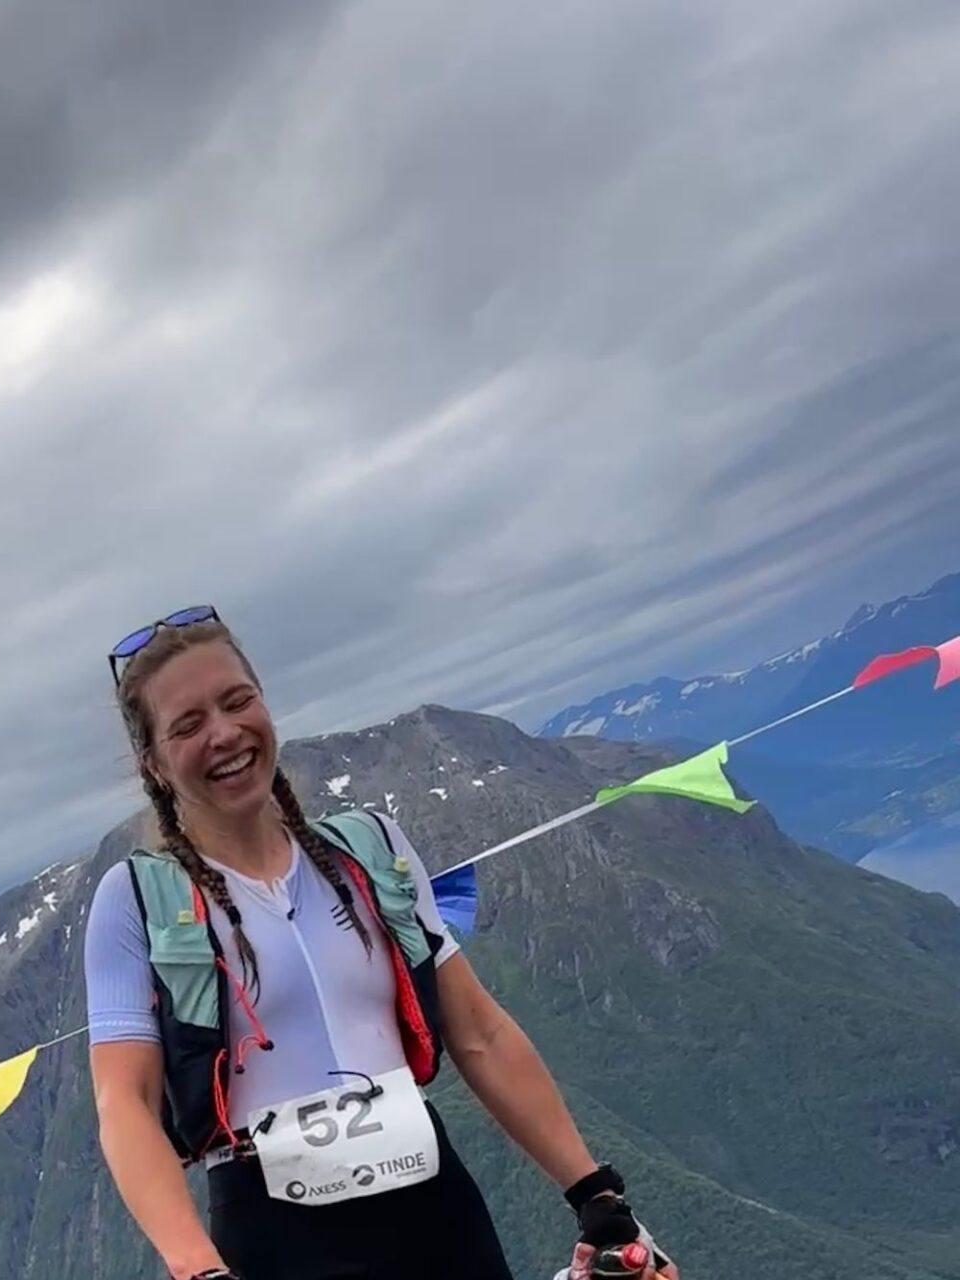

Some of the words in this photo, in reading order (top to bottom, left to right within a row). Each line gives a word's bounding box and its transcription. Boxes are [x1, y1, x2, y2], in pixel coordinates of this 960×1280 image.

[297, 1091, 383, 1147] 52
[376, 1152, 426, 1175] TINDE
[308, 1180, 347, 1197] AXESS
